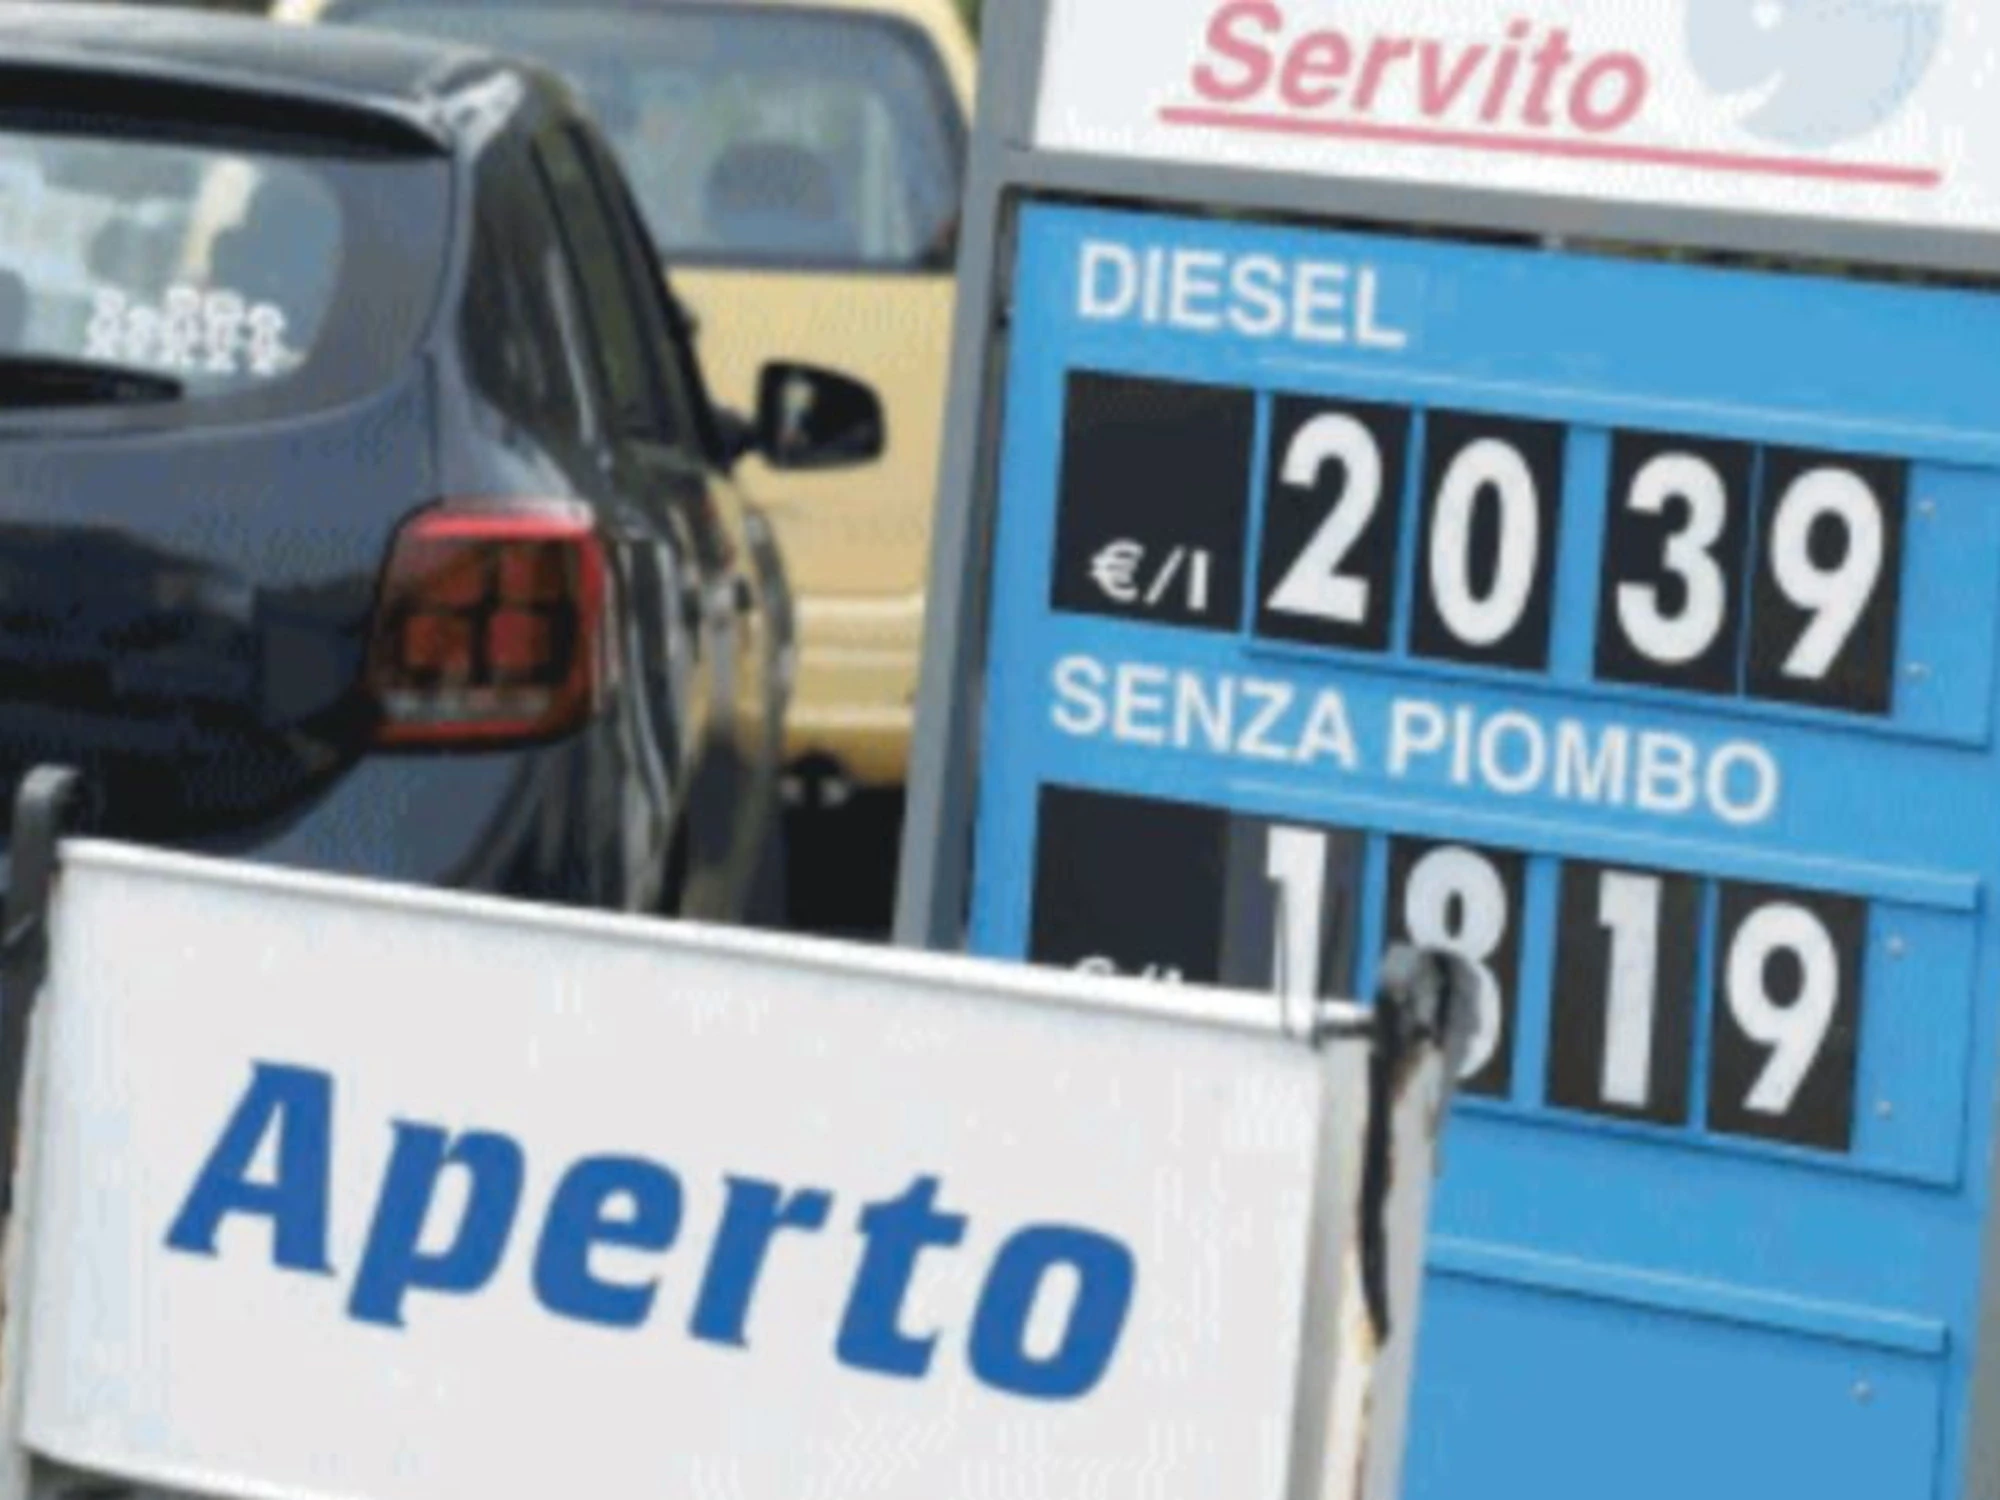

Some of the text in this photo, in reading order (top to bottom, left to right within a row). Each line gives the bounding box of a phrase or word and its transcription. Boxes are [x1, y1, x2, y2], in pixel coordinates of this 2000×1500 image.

[1190, 0, 1649, 132] Servito
[1077, 243, 1408, 347] DIESEL
[1050, 655, 1780, 825] SENZA PIOMBO
[163, 1060, 1137, 1401] Aperto
